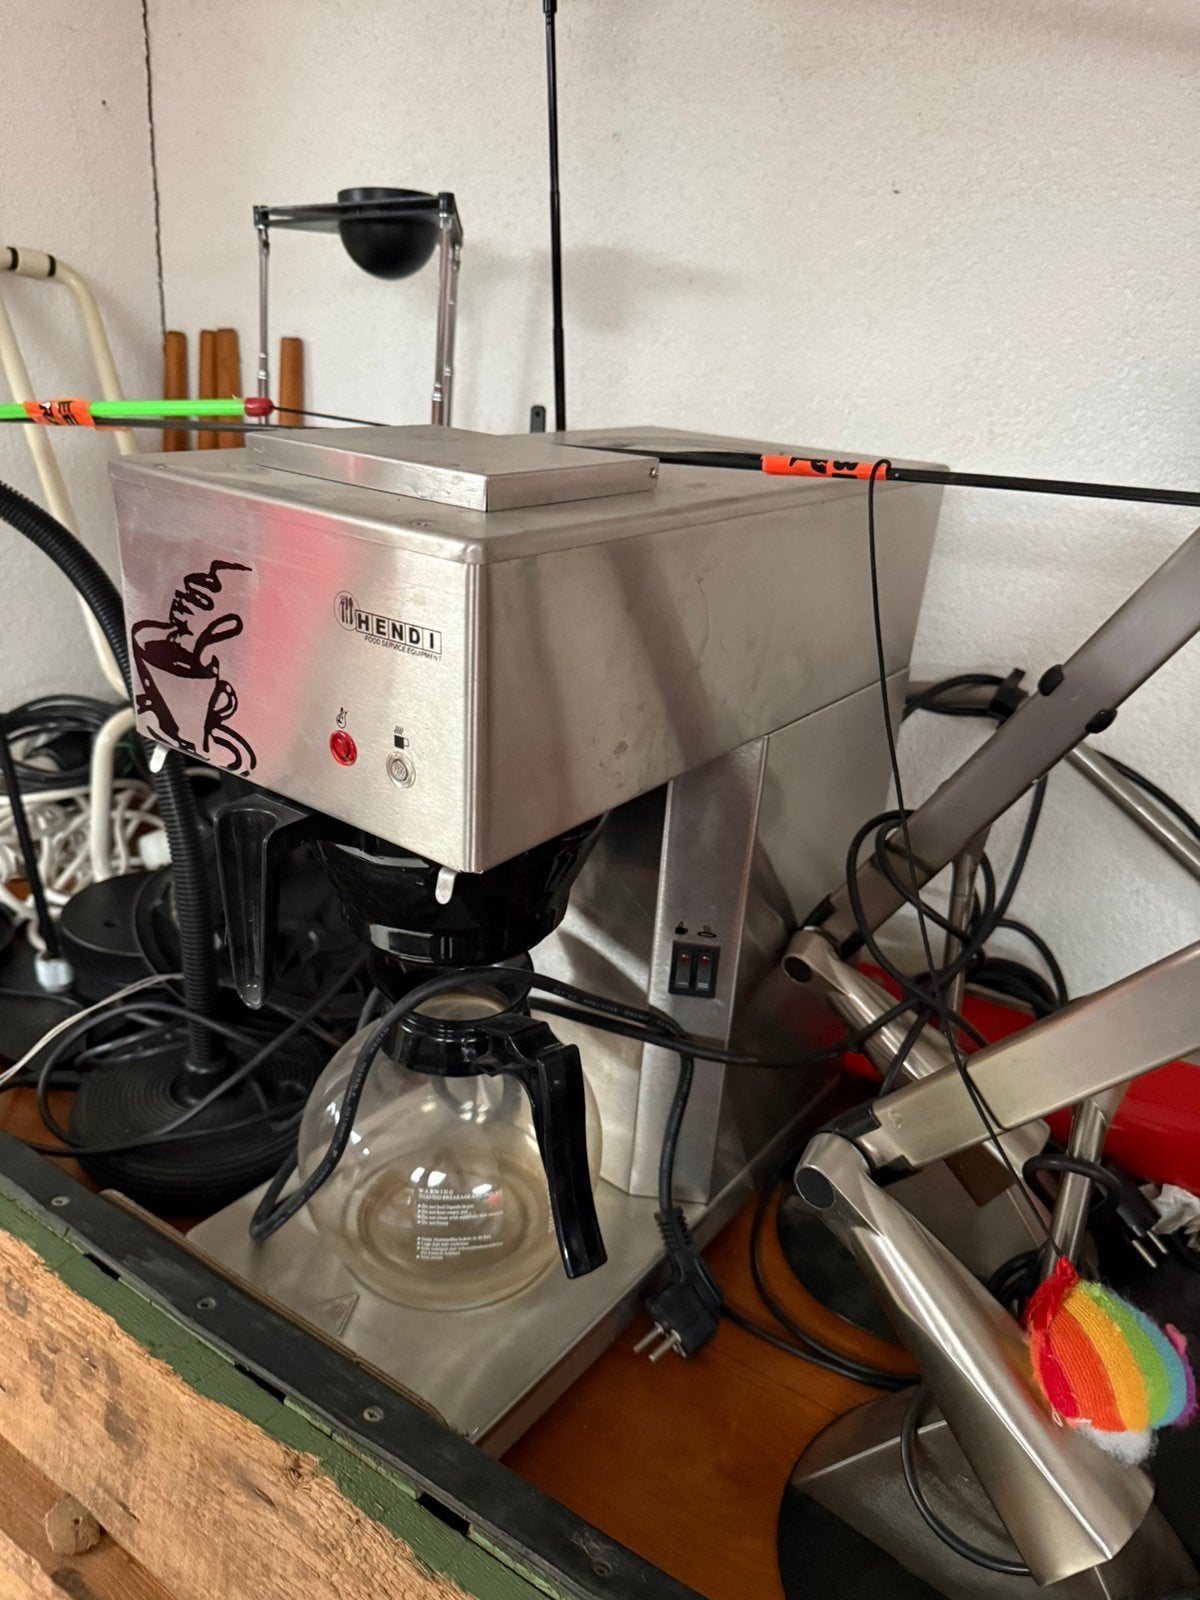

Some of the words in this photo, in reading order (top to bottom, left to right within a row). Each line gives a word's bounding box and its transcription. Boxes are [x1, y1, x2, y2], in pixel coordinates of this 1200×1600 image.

[357, 612, 435, 650] HENDI
[364, 634, 381, 646] FOOD
[381, 639, 406, 654] SERVICE
[406, 647, 442, 662] EQUIPMENT
[418, 1187, 454, 1195] WARNING
